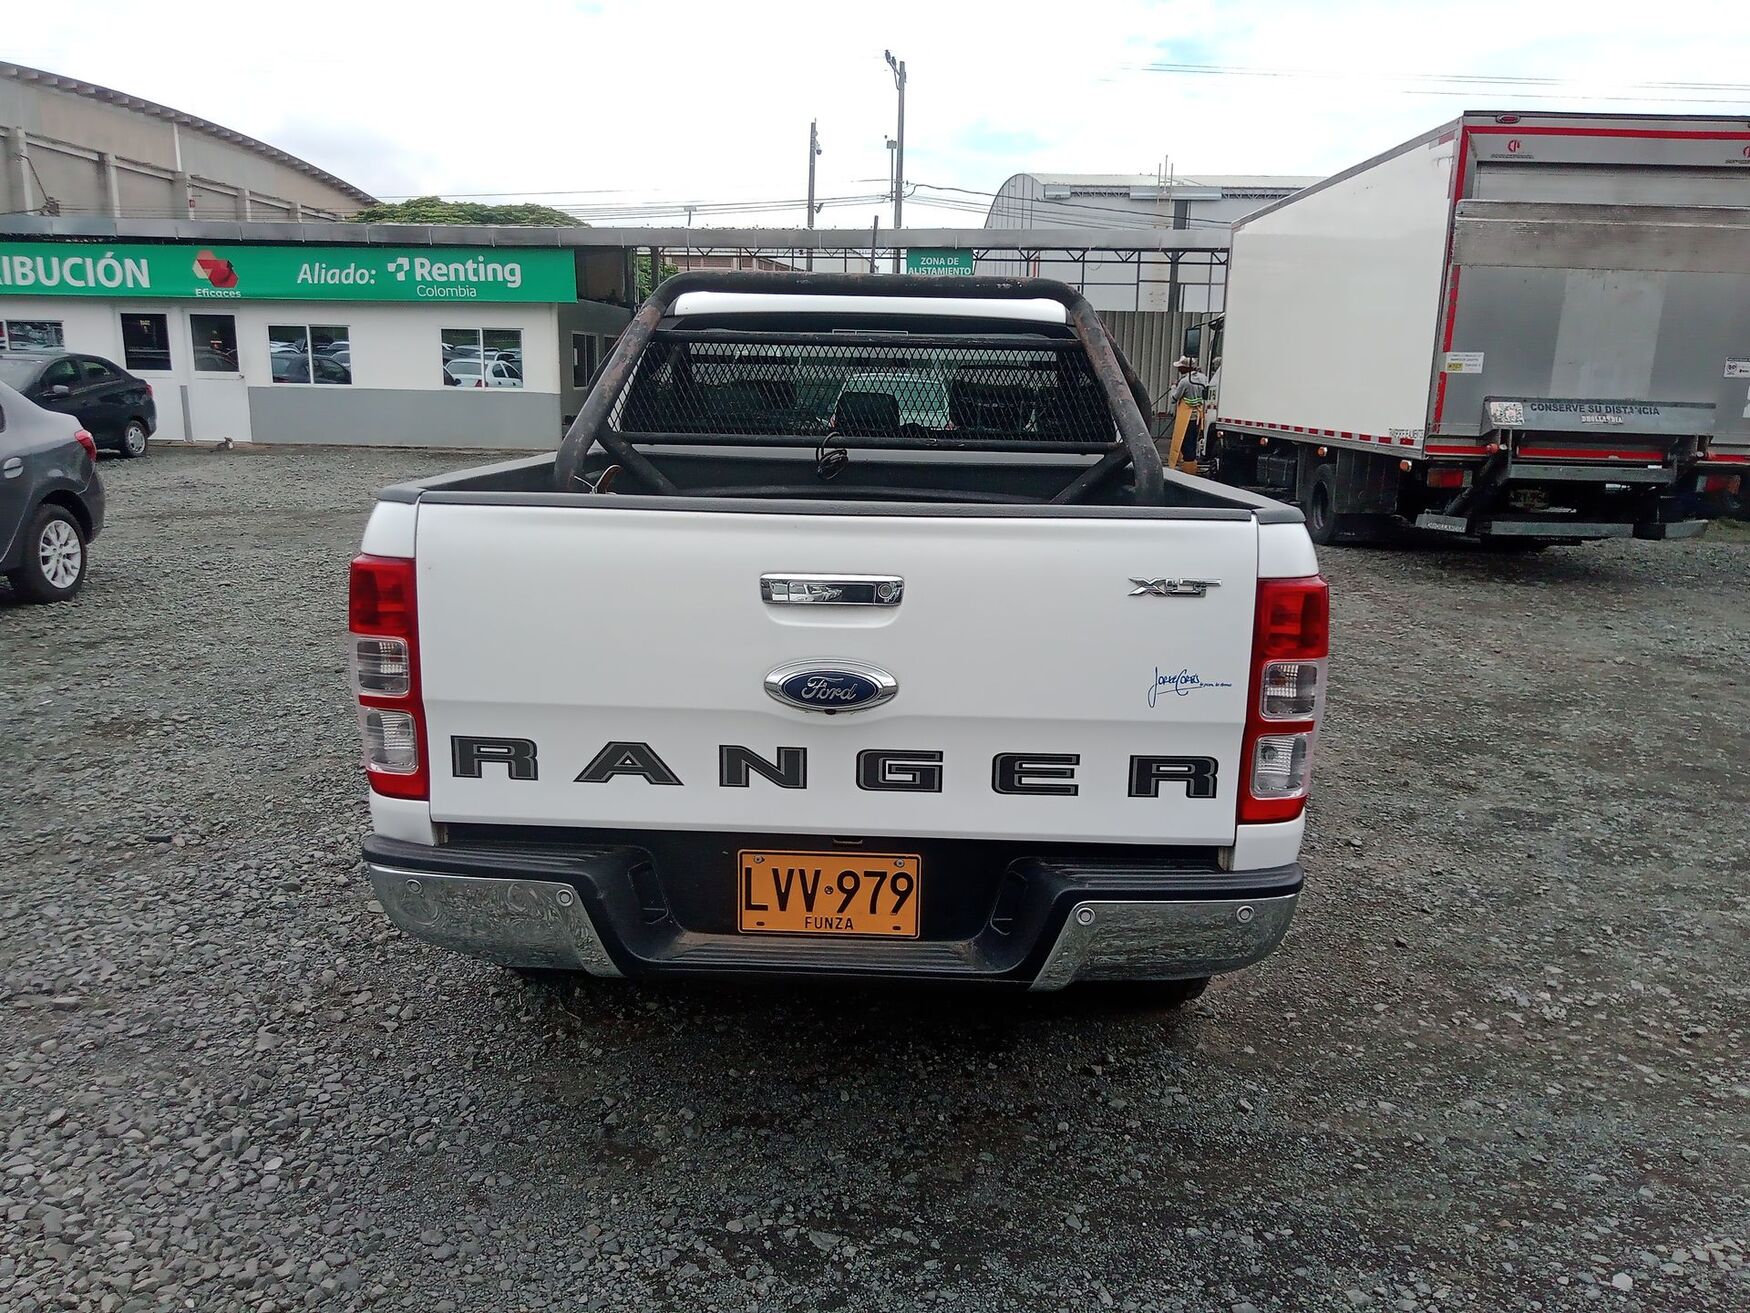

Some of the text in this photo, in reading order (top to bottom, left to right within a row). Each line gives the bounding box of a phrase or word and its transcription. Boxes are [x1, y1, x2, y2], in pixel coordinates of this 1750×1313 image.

[0, 251, 151, 288] IBUCIÓN
[920, 257, 959, 265] ZONA DE
[297, 263, 376, 285] Aliado:
[414, 255, 522, 288] Renting
[908, 267, 971, 275] ALISTAMIENTO
[195, 288, 241, 298] Eficaces
[416, 285, 477, 297] Colombia
[1530, 403, 1586, 414] CONSERVE
[1588, 404, 1602, 415] SU
[1128, 577, 1222, 598] XLT
[801, 676, 858, 700] Ford
[450, 735, 1219, 798] RANGER
[804, 916, 855, 930] FUNZA
